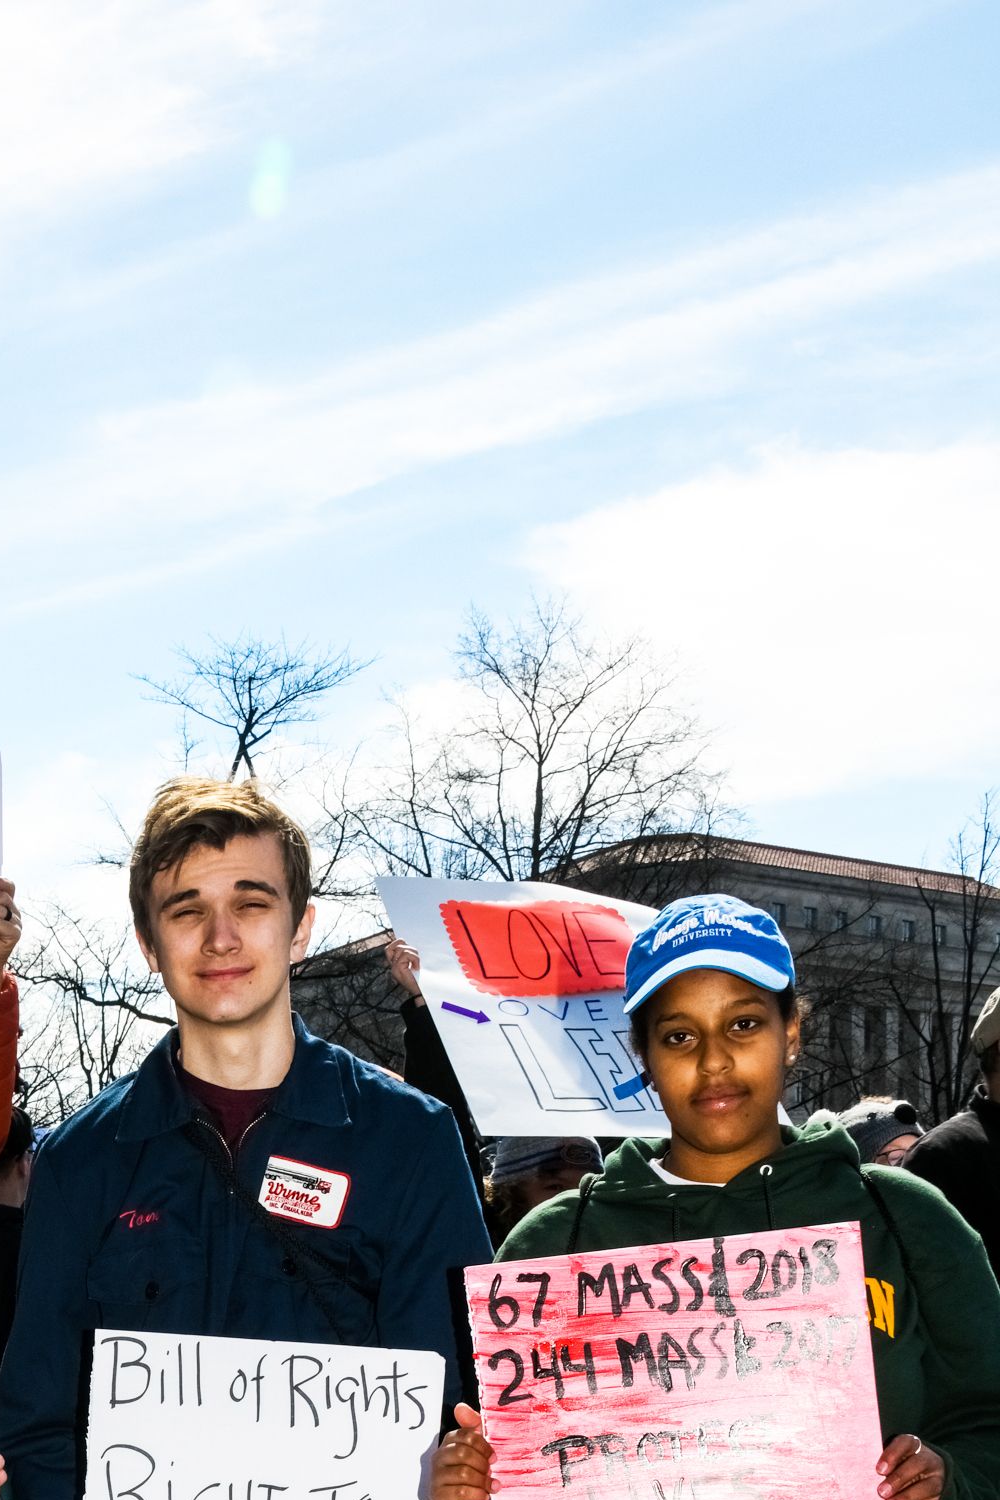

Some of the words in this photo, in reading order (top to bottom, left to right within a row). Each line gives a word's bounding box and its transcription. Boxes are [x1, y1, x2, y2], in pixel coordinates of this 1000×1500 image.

[456, 909, 626, 981] LOVE
[672, 928, 733, 948] UNIVERSITY
[498, 996, 626, 1022] OVE
[268, 1181, 320, 1206] Wynne
[488, 1272, 550, 1330] 67
[736, 1238, 840, 1301] 2018
[863, 1277, 895, 1338] N
[101, 1336, 202, 1409] Bill
[229, 1353, 268, 1423] of
[281, 1354, 429, 1460] Rights
[487, 1341, 598, 1407] 244
